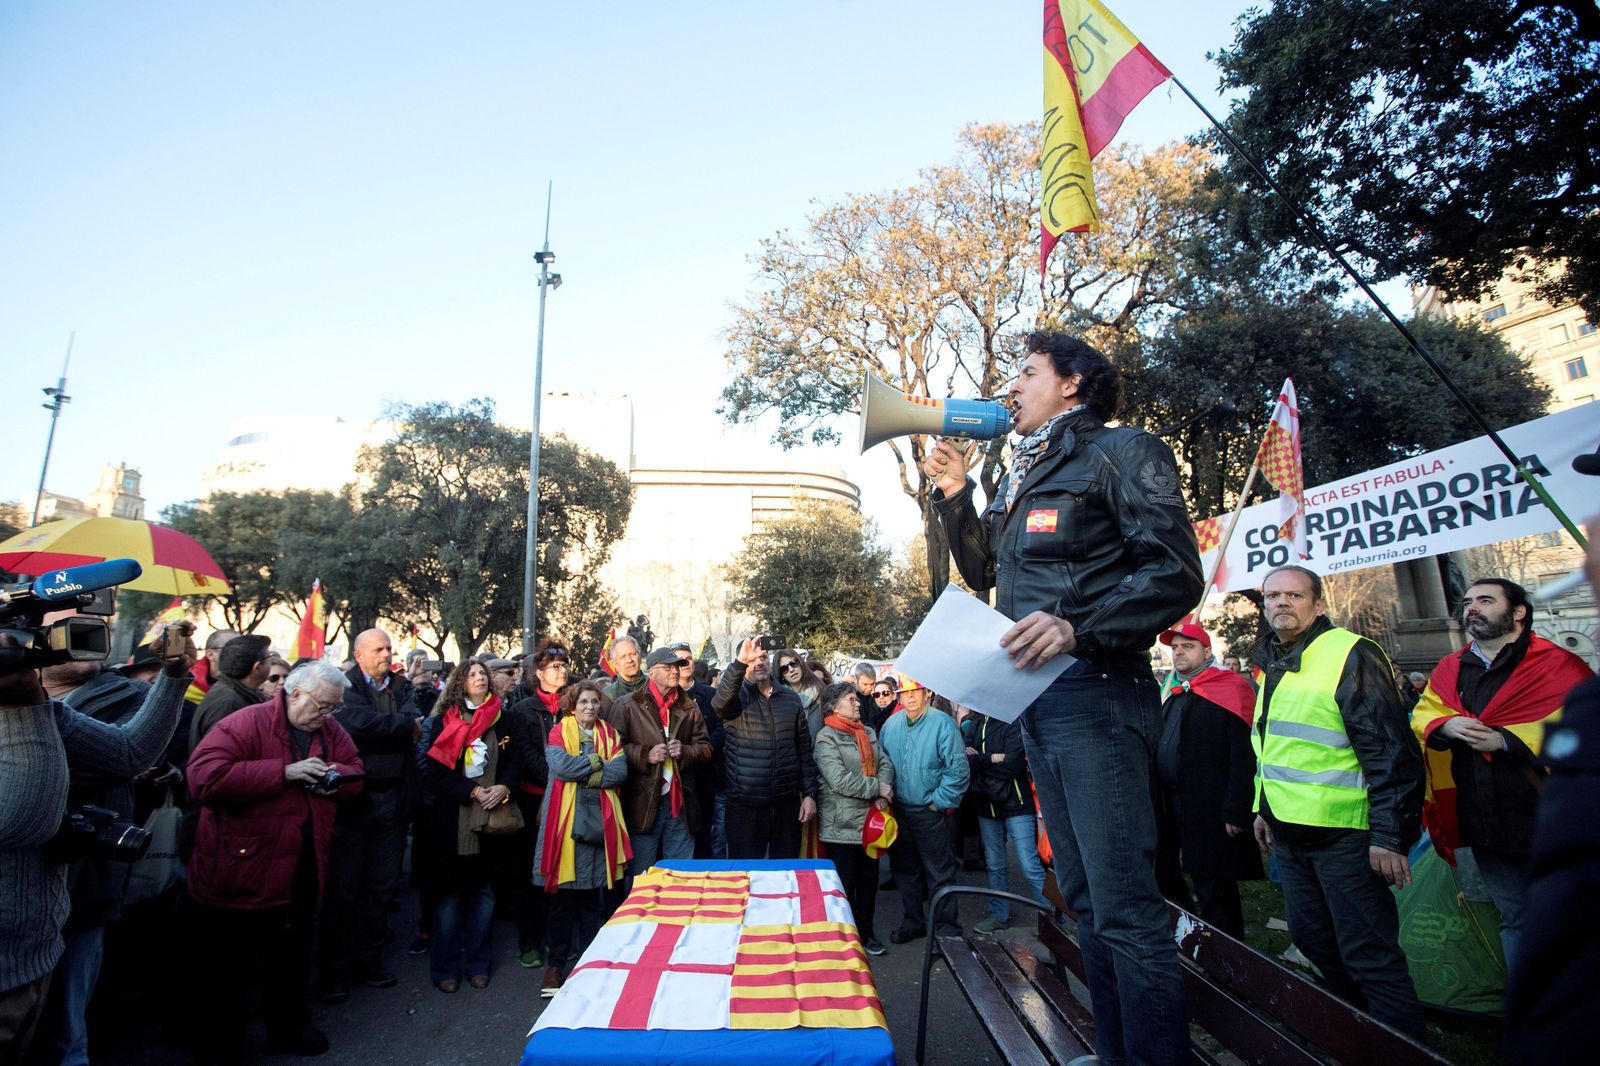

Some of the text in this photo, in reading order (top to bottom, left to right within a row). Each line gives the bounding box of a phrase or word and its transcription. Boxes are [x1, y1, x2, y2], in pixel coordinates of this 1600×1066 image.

[1341, 480, 1370, 498] EST
[1373, 459, 1446, 489] FABULA
[1245, 453, 1552, 549] CORDINADORA
[1320, 482, 1547, 557] TABARNIA
[1328, 543, 1428, 571] cptabarnia.org
[45, 583, 83, 597] Pueblo
[55, 570, 68, 584] Ñ
